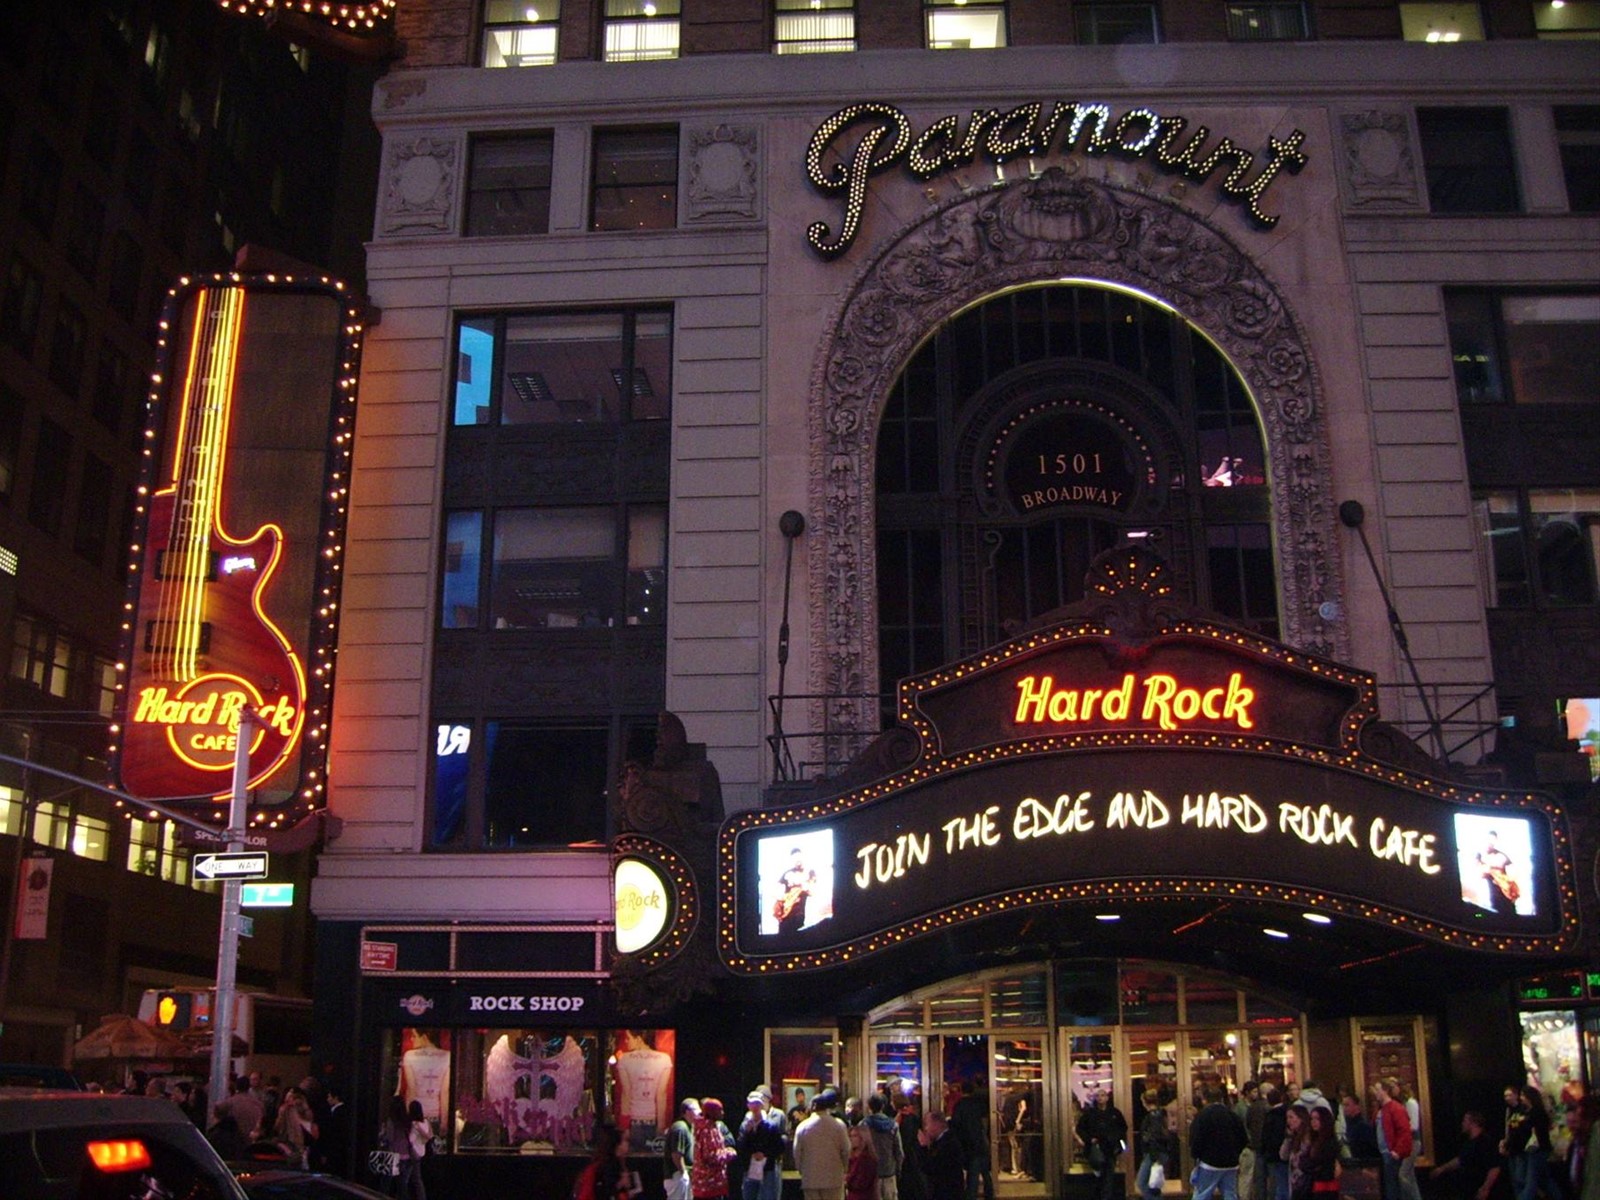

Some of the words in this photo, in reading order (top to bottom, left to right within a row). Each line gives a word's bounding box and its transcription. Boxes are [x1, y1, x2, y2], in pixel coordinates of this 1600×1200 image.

[806, 100, 1309, 261] Paramount
[1038, 453, 1102, 475] 1501
[1021, 485, 1122, 509] BROADWAY
[134, 688, 219, 724] Hard
[217, 691, 295, 737] Rck
[1015, 674, 1135, 722] Hard
[1142, 672, 1254, 730] Rock
[855, 832, 930, 889] JOIN
[942, 805, 1001, 854] THE
[1013, 791, 1095, 840] EDGE
[1107, 790, 1170, 830] AND
[1181, 791, 1268, 833] HARD
[1278, 802, 1359, 848] ROCK
[1369, 816, 1441, 875] CAFE
[205, 862, 224, 872] ONE
[238, 861, 258, 870] WAY
[470, 996, 525, 1011] ROCK
[529, 996, 585, 1011] SHOP
